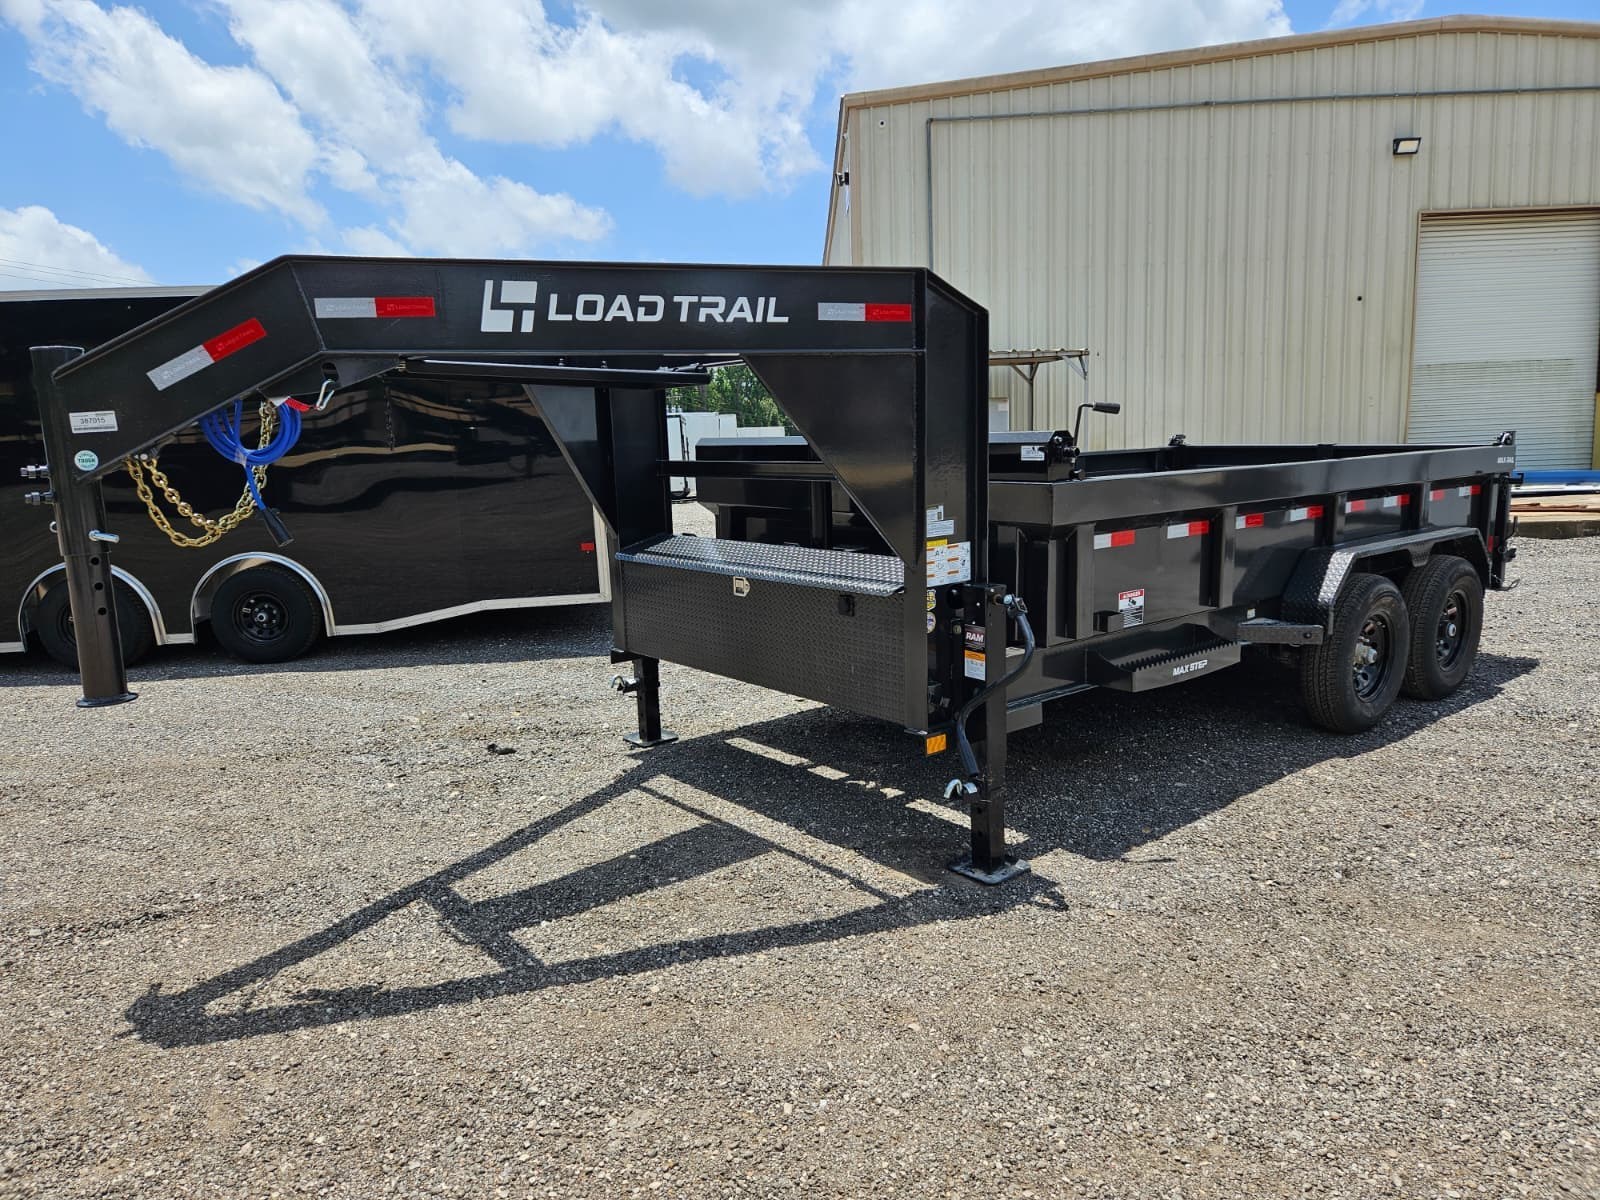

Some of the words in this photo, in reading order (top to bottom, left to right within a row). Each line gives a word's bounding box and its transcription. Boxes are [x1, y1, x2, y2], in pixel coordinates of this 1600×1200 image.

[548, 293, 665, 323] LOAD
[673, 295, 790, 324] TRAIL
[965, 631, 984, 643] RAM
[1172, 664, 1189, 676] MAX
[1190, 659, 1209, 671] STEP
